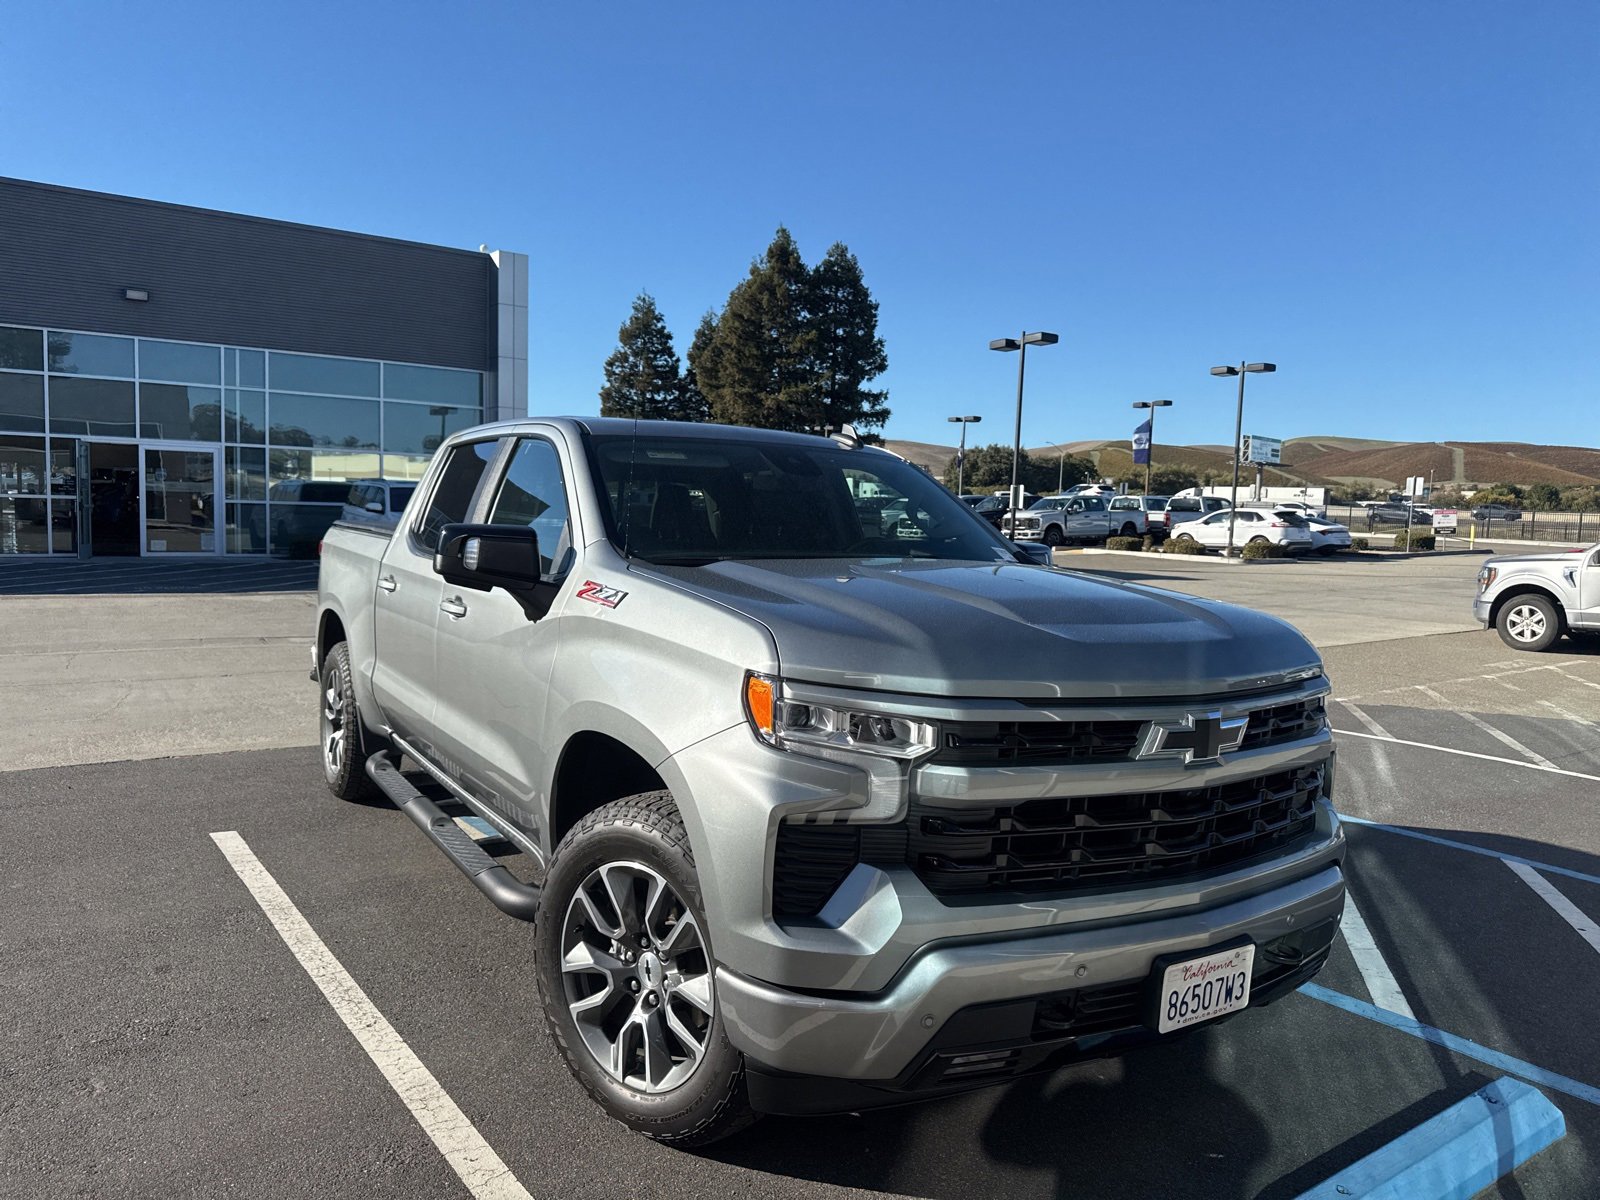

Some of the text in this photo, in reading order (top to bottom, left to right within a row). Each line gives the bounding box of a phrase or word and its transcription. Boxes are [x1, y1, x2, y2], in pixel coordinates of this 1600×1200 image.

[1183, 960, 1238, 981] California
[1167, 971, 1246, 1021] 86507W3
[1182, 1006, 1228, 1024] dmv.ca.gov
